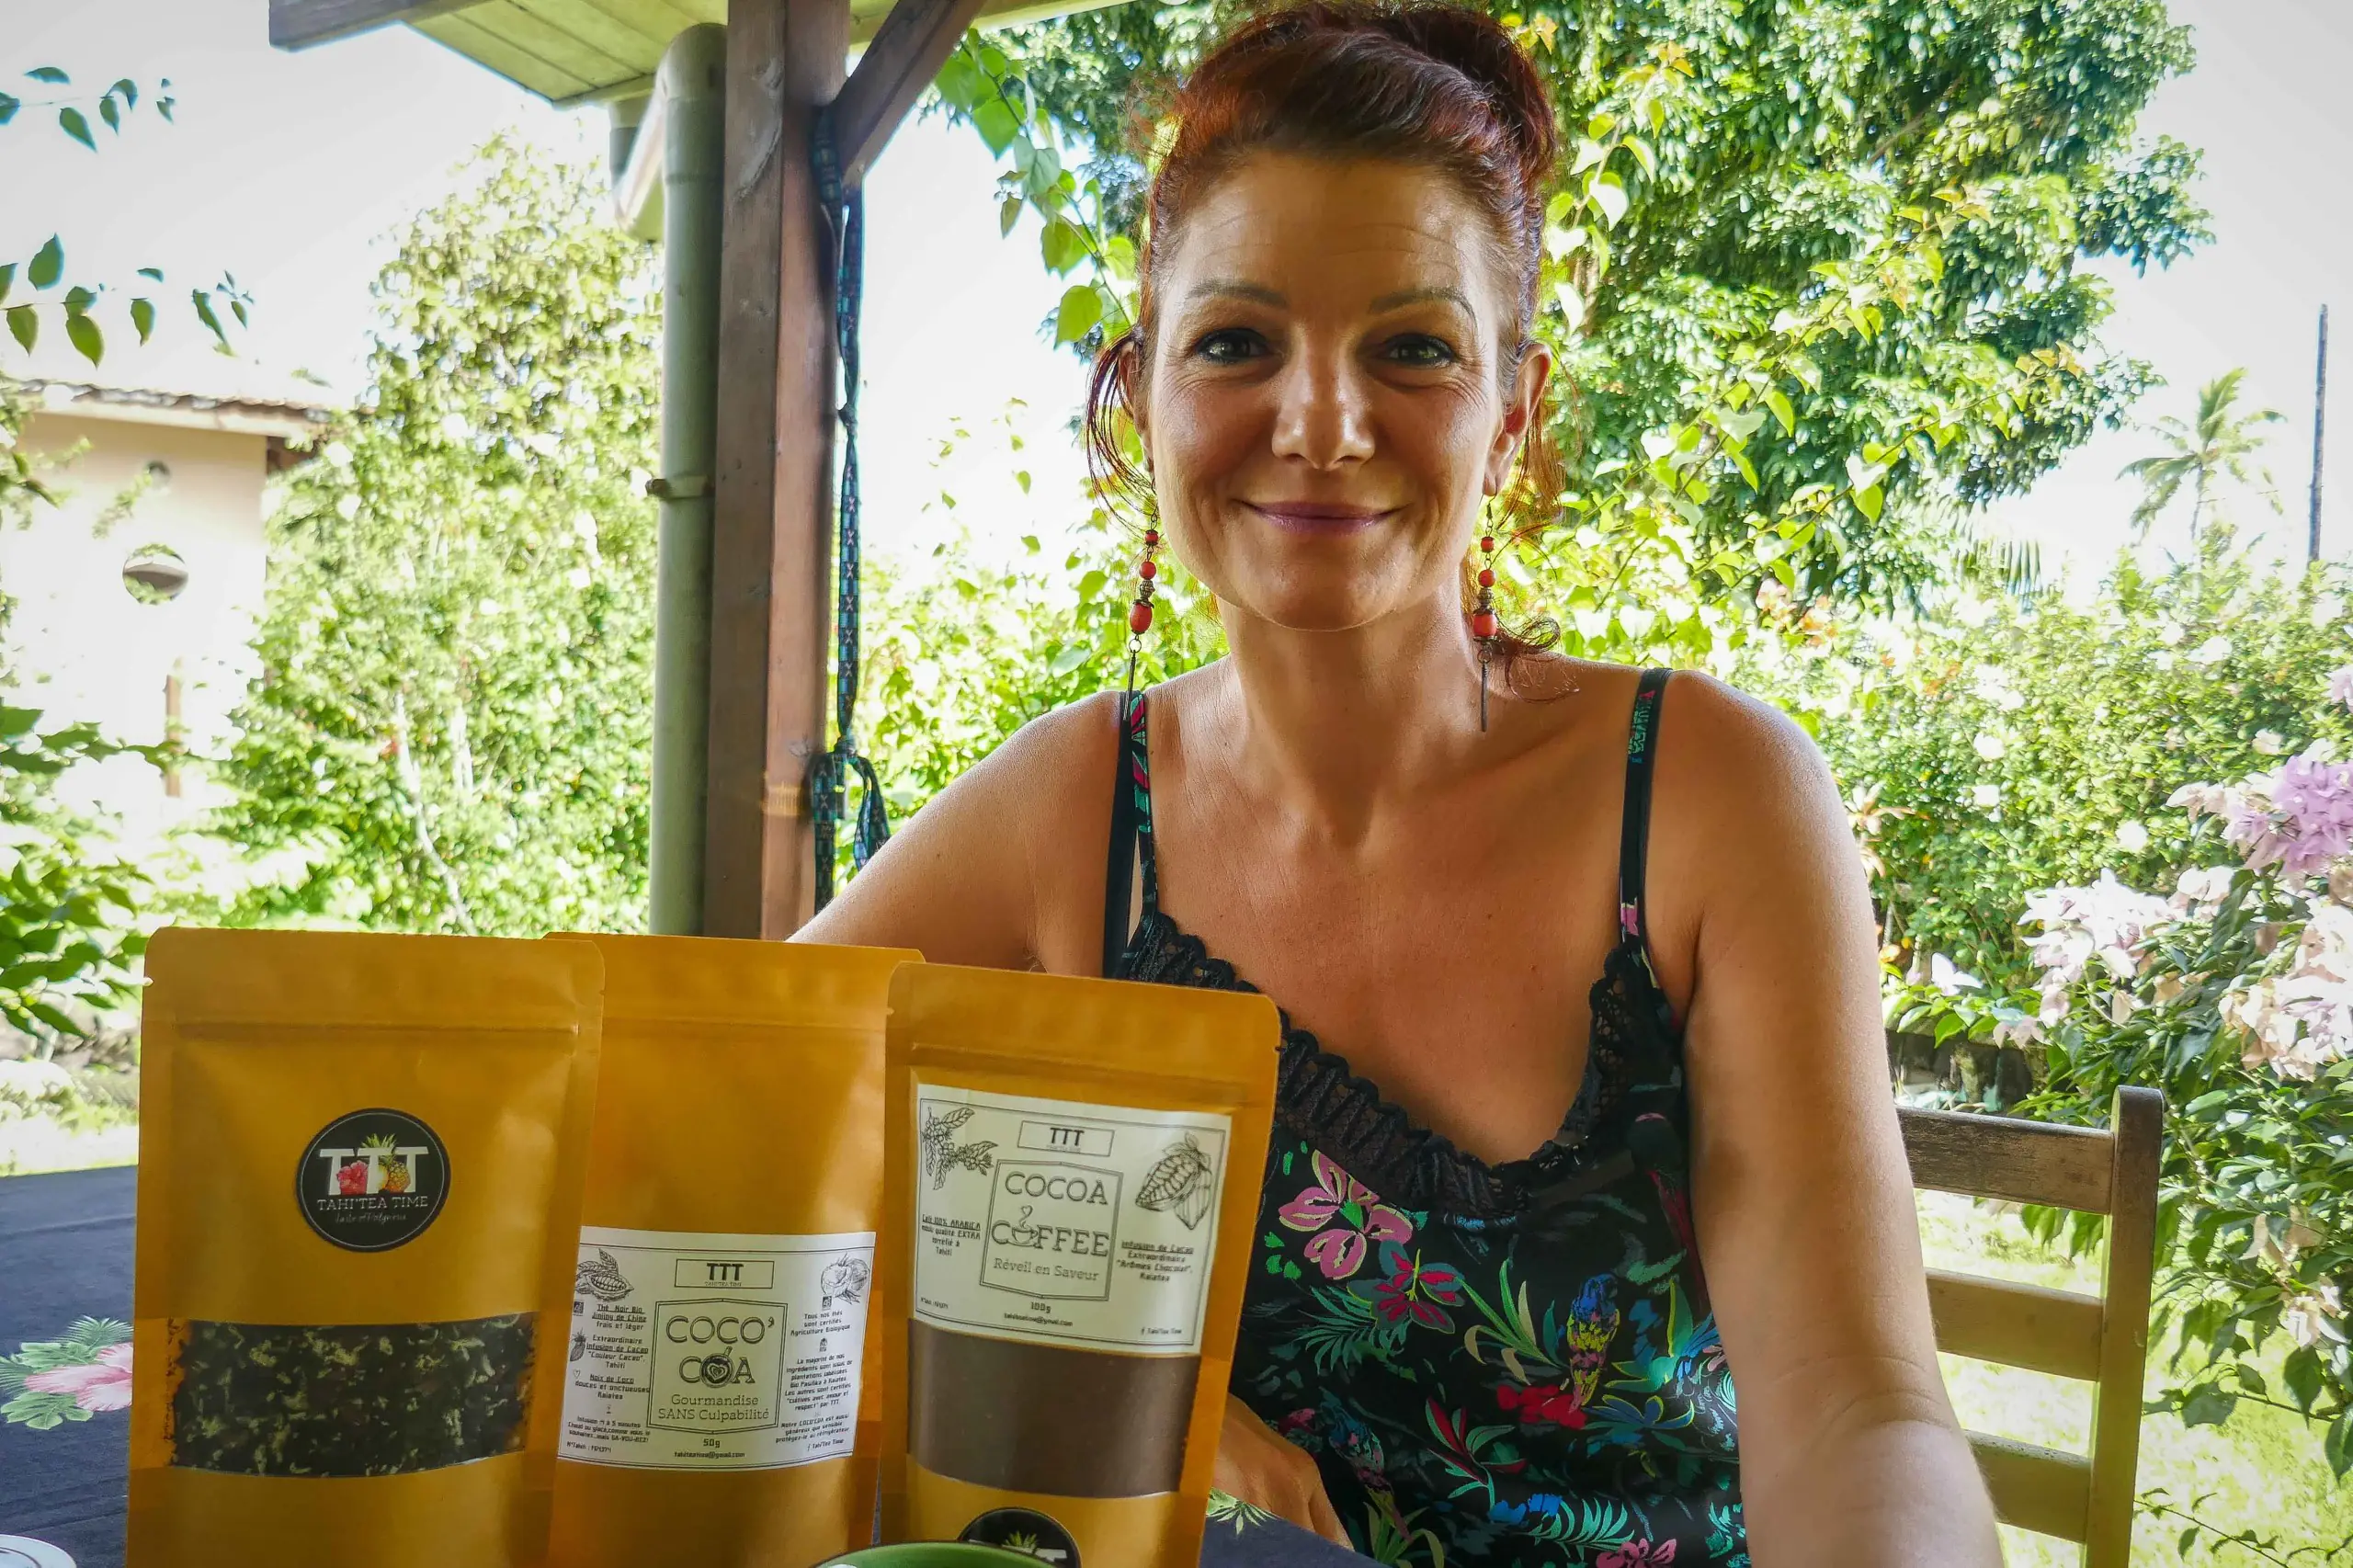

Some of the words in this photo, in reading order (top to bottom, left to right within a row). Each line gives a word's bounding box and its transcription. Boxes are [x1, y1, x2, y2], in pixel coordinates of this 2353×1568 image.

[1050, 1127, 1085, 1146] TTT
[319, 1146, 429, 1196] TTT
[1005, 1170, 1108, 1205] COCOA
[316, 1197, 388, 1210] TAHI'TEA
[392, 1196, 429, 1209] TIME
[950, 1219, 981, 1231] ARABICA
[958, 1230, 981, 1240] EXTRA
[707, 1263, 744, 1280] TTT
[993, 1257, 1032, 1273] Réveil
[1035, 1264, 1051, 1275] en
[1054, 1265, 1100, 1280] Saveur
[615, 1305, 629, 1313] Noir
[1030, 1301, 1051, 1313] 100g
[626, 1324, 643, 1332] léger
[790, 1327, 824, 1336] Agriculture
[593, 1334, 643, 1345] Extraordinaire
[585, 1343, 614, 1352] Infusion
[616, 1345, 625, 1353] de
[627, 1346, 649, 1354] Cacao
[606, 1360, 626, 1369] Tahiti
[617, 1376, 634, 1385] Coco
[574, 1381, 597, 1389] douces
[609, 1385, 650, 1393] onctueuses
[671, 1393, 759, 1406] Gourmandise
[658, 1408, 696, 1420] SANS
[699, 1408, 769, 1423] Culpabilité
[702, 1438, 721, 1449] 50g
